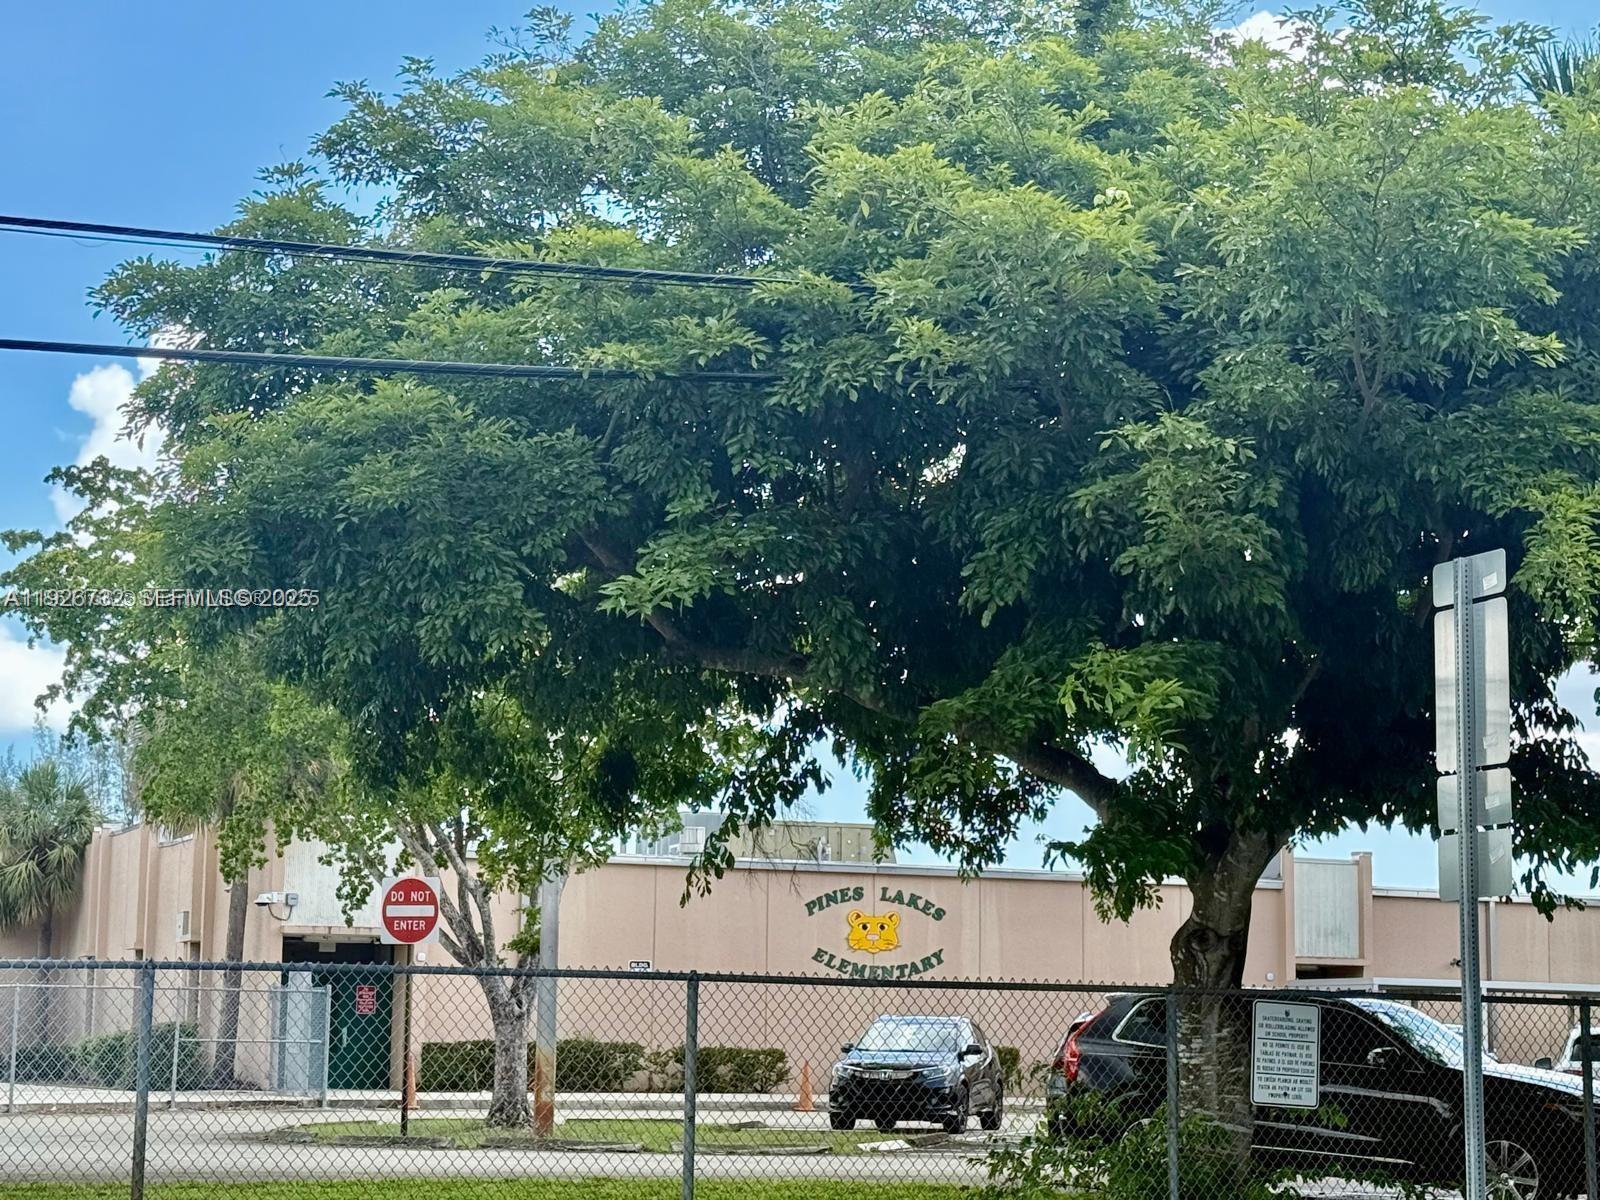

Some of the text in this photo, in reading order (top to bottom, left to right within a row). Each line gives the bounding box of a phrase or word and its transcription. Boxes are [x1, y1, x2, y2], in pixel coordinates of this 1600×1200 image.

[391, 891, 431, 902] DO NOT
[804, 887, 946, 921] PINES LAKES
[394, 920, 426, 931] ENTER
[811, 948, 945, 980] ELEMENTARY
